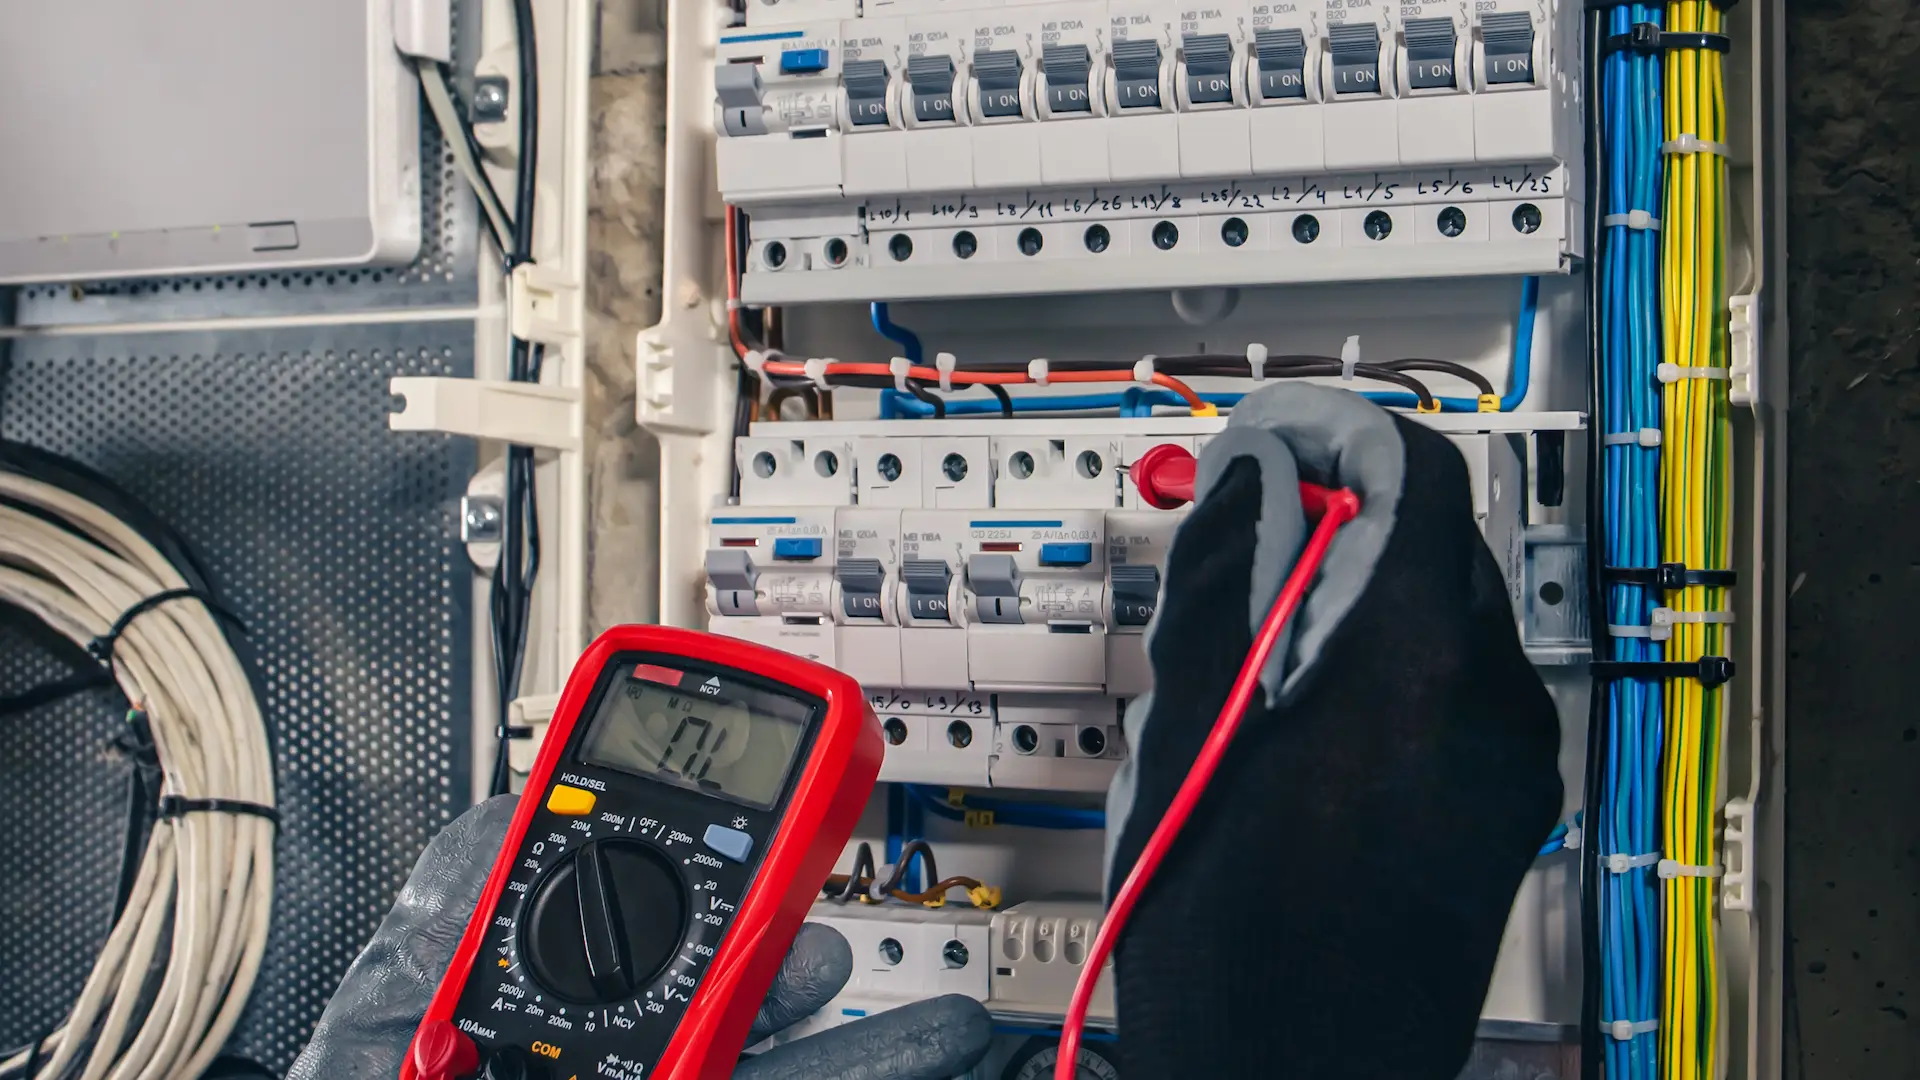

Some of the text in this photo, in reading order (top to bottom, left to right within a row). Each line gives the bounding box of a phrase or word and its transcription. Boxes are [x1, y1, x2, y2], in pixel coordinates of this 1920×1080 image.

[1400, 6, 1421, 15] B20
[1476, 1, 1496, 11] B20
[1432, 64, 1452, 77] ON
[1507, 60, 1528, 72] ON
[1282, 74, 1301, 86] ON
[1356, 70, 1375, 82] ON
[1139, 86, 1157, 97] ON
[1210, 80, 1229, 91] ON
[1000, 96, 1018, 106] ON
[1070, 90, 1088, 100] ON
[870, 104, 886, 114] ON
[934, 100, 951, 110] ON
[1418, 180, 1473, 195] L5/6
[1492, 172, 1552, 193] L4/25
[1344, 182, 1400, 201] L1/5
[998, 200, 1052, 218] L8/11
[1064, 195, 1122, 214] L6/26
[844, 442, 853, 452] N
[1110, 442, 1118, 452] N
[971, 531, 986, 539] CD
[864, 598, 880, 608] ON
[929, 600, 947, 610] ON
[700, 684, 720, 696] NCV
[561, 772, 607, 792] HOLD/SEL
[601, 812, 625, 825] 200M
[639, 817, 658, 828] OFF
[571, 820, 591, 832] 20M
[548, 832, 568, 845] 200k
[668, 830, 694, 845] 200m
[532, 841, 545, 856] Ω
[524, 858, 539, 869] 20k
[692, 853, 723, 869] 2000m
[508, 881, 528, 892] 2000
[704, 880, 718, 891] 20
[495, 916, 511, 927] 200
[704, 913, 723, 926] 200
[1010, 921, 1017, 935] 7
[1070, 925, 1080, 938] 9
[696, 944, 714, 957] 600
[677, 974, 696, 988] 600
[525, 1003, 544, 1017] 20m
[646, 1000, 664, 1014] 200
[547, 1015, 573, 1030] 200m
[584, 1022, 595, 1032] 10
[613, 1015, 636, 1030] NCV
[532, 1041, 562, 1059] COM
